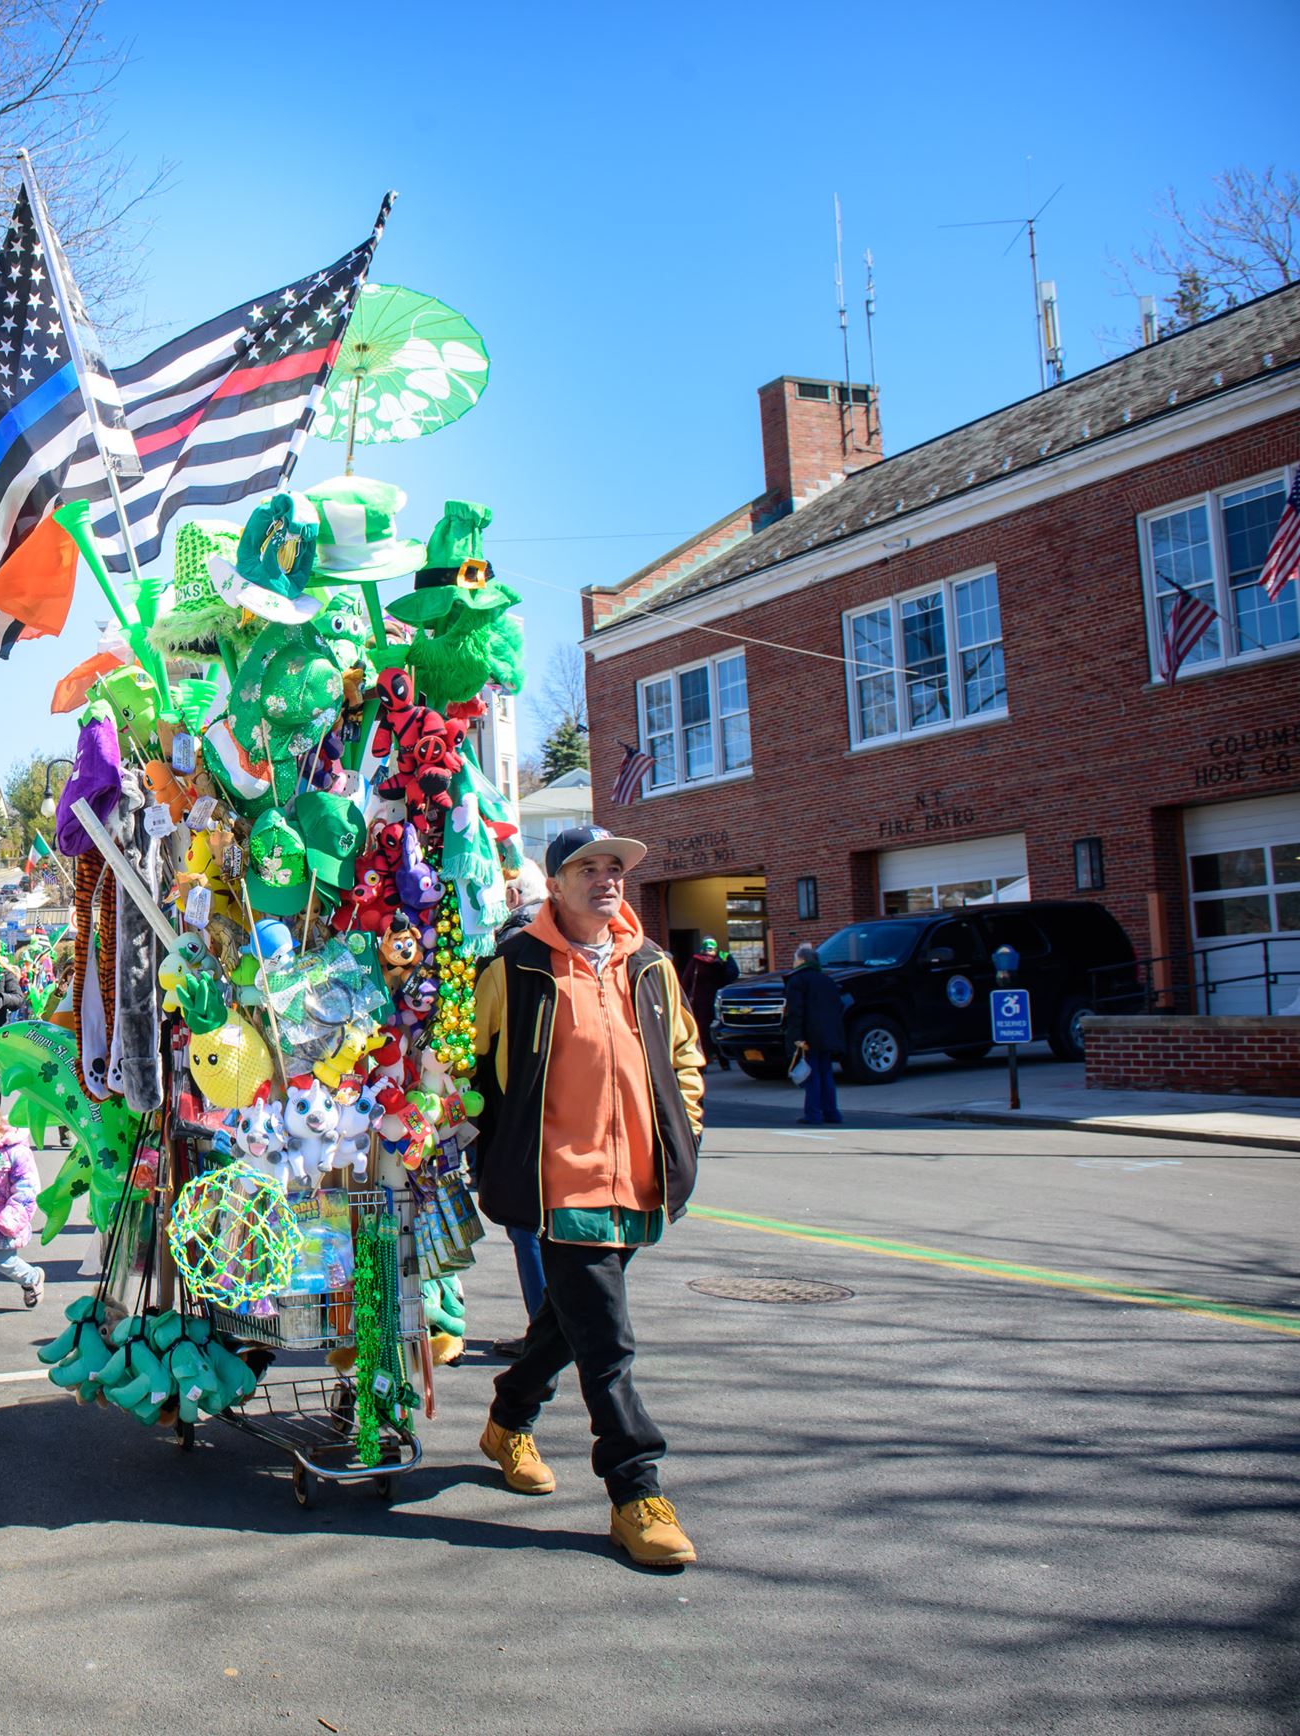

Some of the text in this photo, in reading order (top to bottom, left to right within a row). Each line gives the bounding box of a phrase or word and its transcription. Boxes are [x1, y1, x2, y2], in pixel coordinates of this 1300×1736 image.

[1196, 756, 1246, 786] HOSE
[879, 819, 914, 837] FIRE
[25, 1029, 54, 1049] Happy
[88, 1102, 103, 1123] Day
